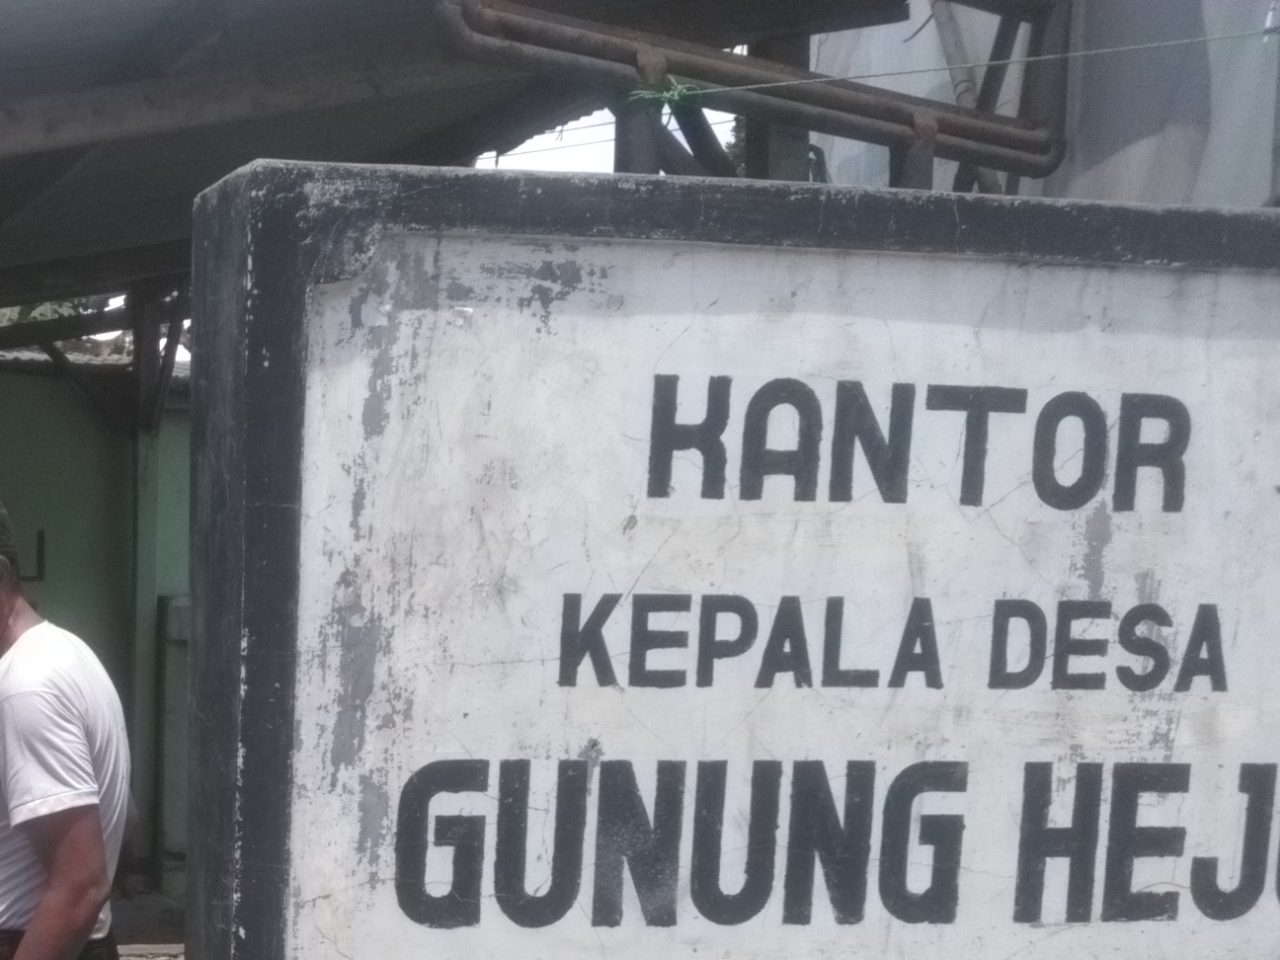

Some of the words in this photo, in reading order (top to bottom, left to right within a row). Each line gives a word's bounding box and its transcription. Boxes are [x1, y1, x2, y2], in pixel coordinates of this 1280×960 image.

[647, 376, 1190, 512] KANTOR
[558, 594, 941, 689] KEPALA
[988, 600, 1226, 692] DESA
[394, 758, 967, 929] GUNUNG
[1014, 762, 1280, 923] HEJ
